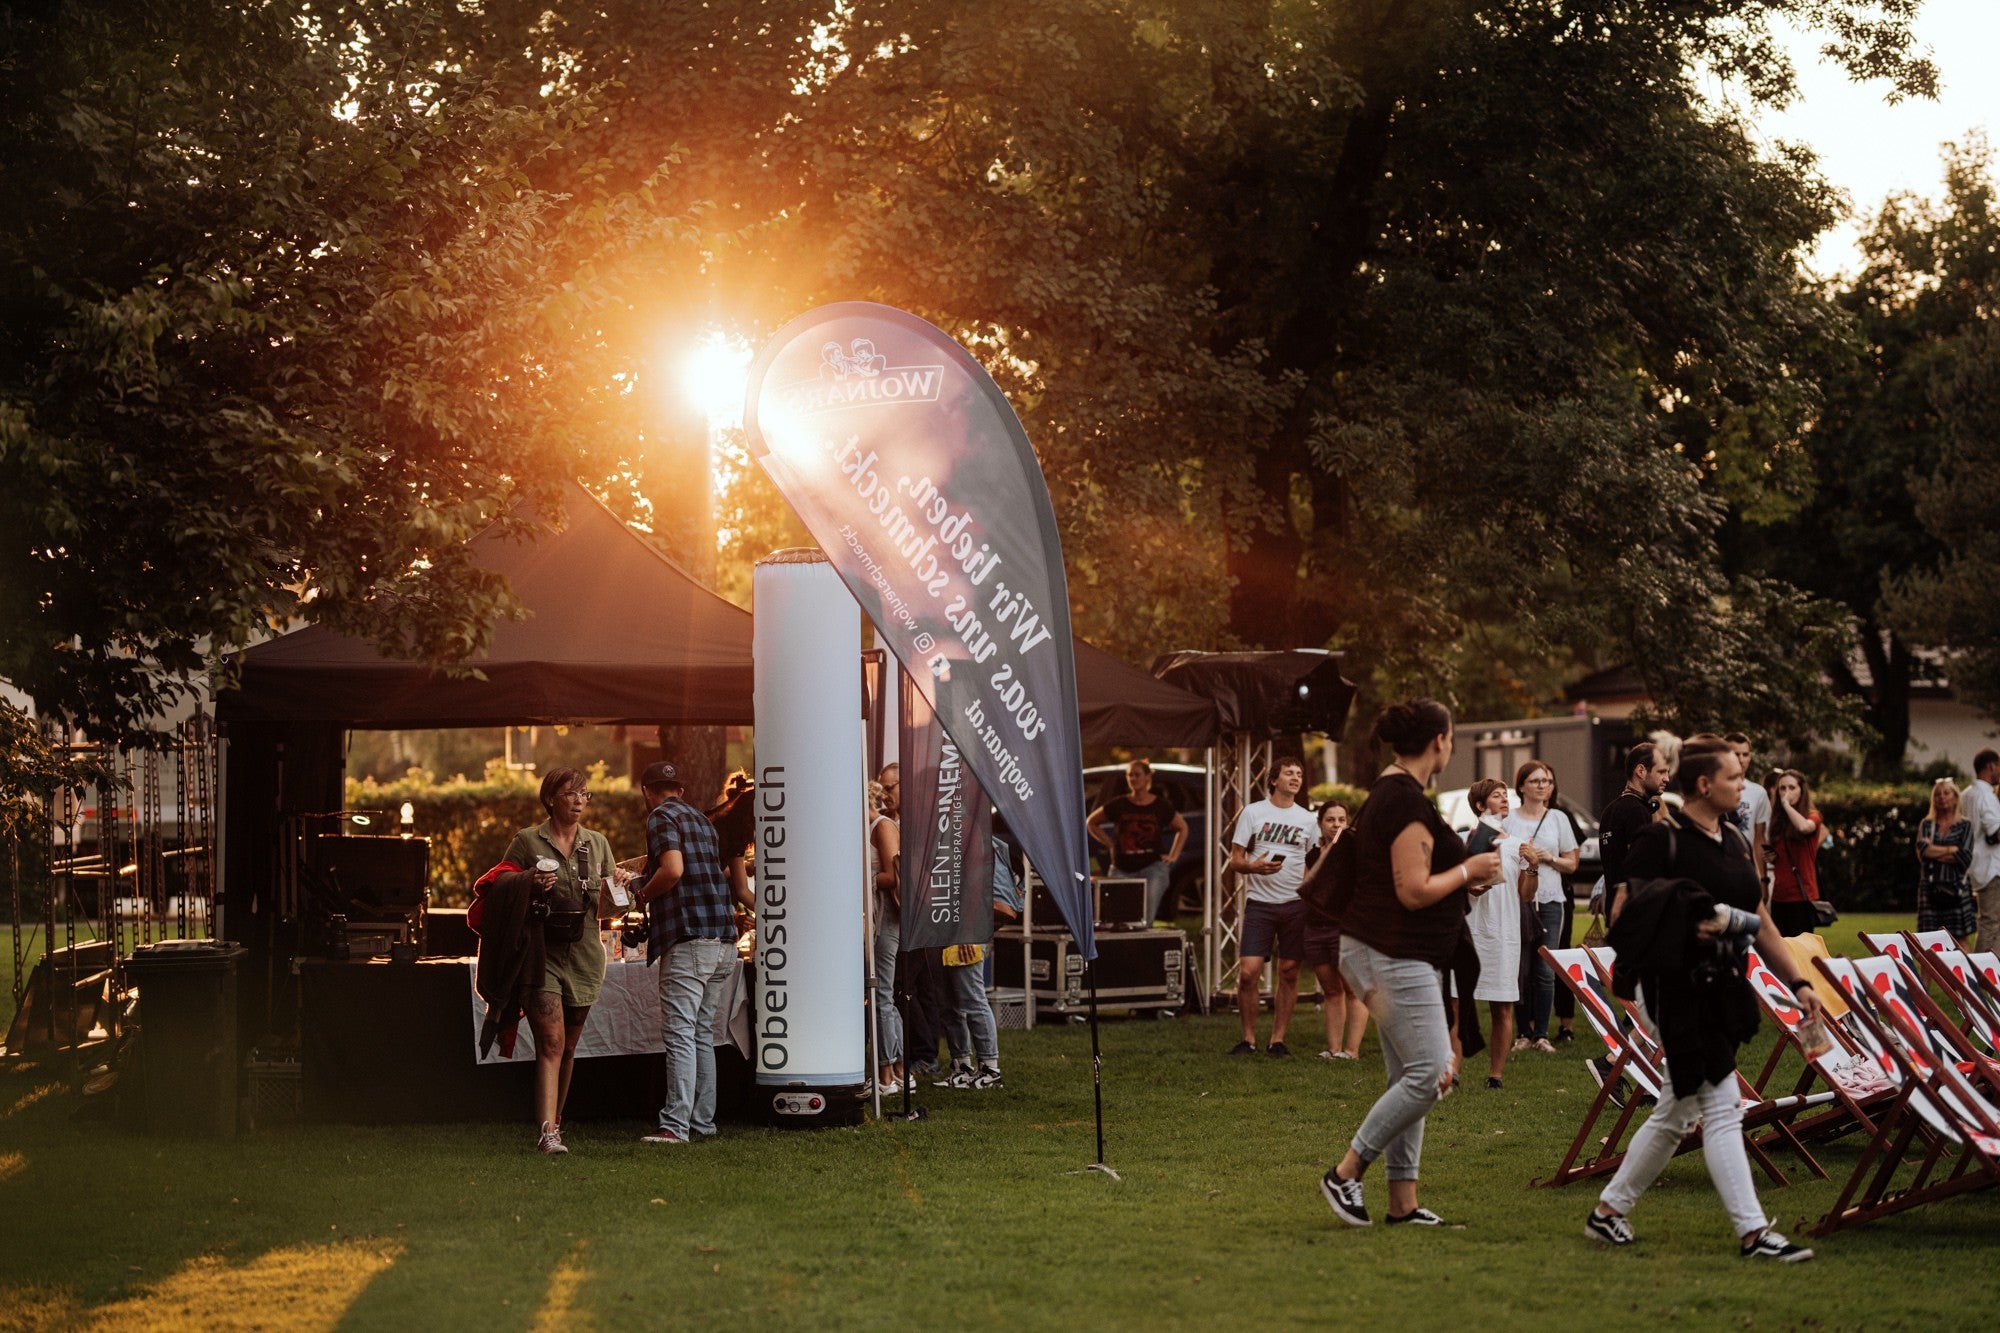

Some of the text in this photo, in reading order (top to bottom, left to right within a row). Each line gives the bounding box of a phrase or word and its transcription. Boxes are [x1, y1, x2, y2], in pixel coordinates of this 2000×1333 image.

[952, 793, 962, 895] MEHRSPRACHIGE
[1257, 822, 1303, 846] NIKE
[759, 766, 788, 1070] Oberösterreich
